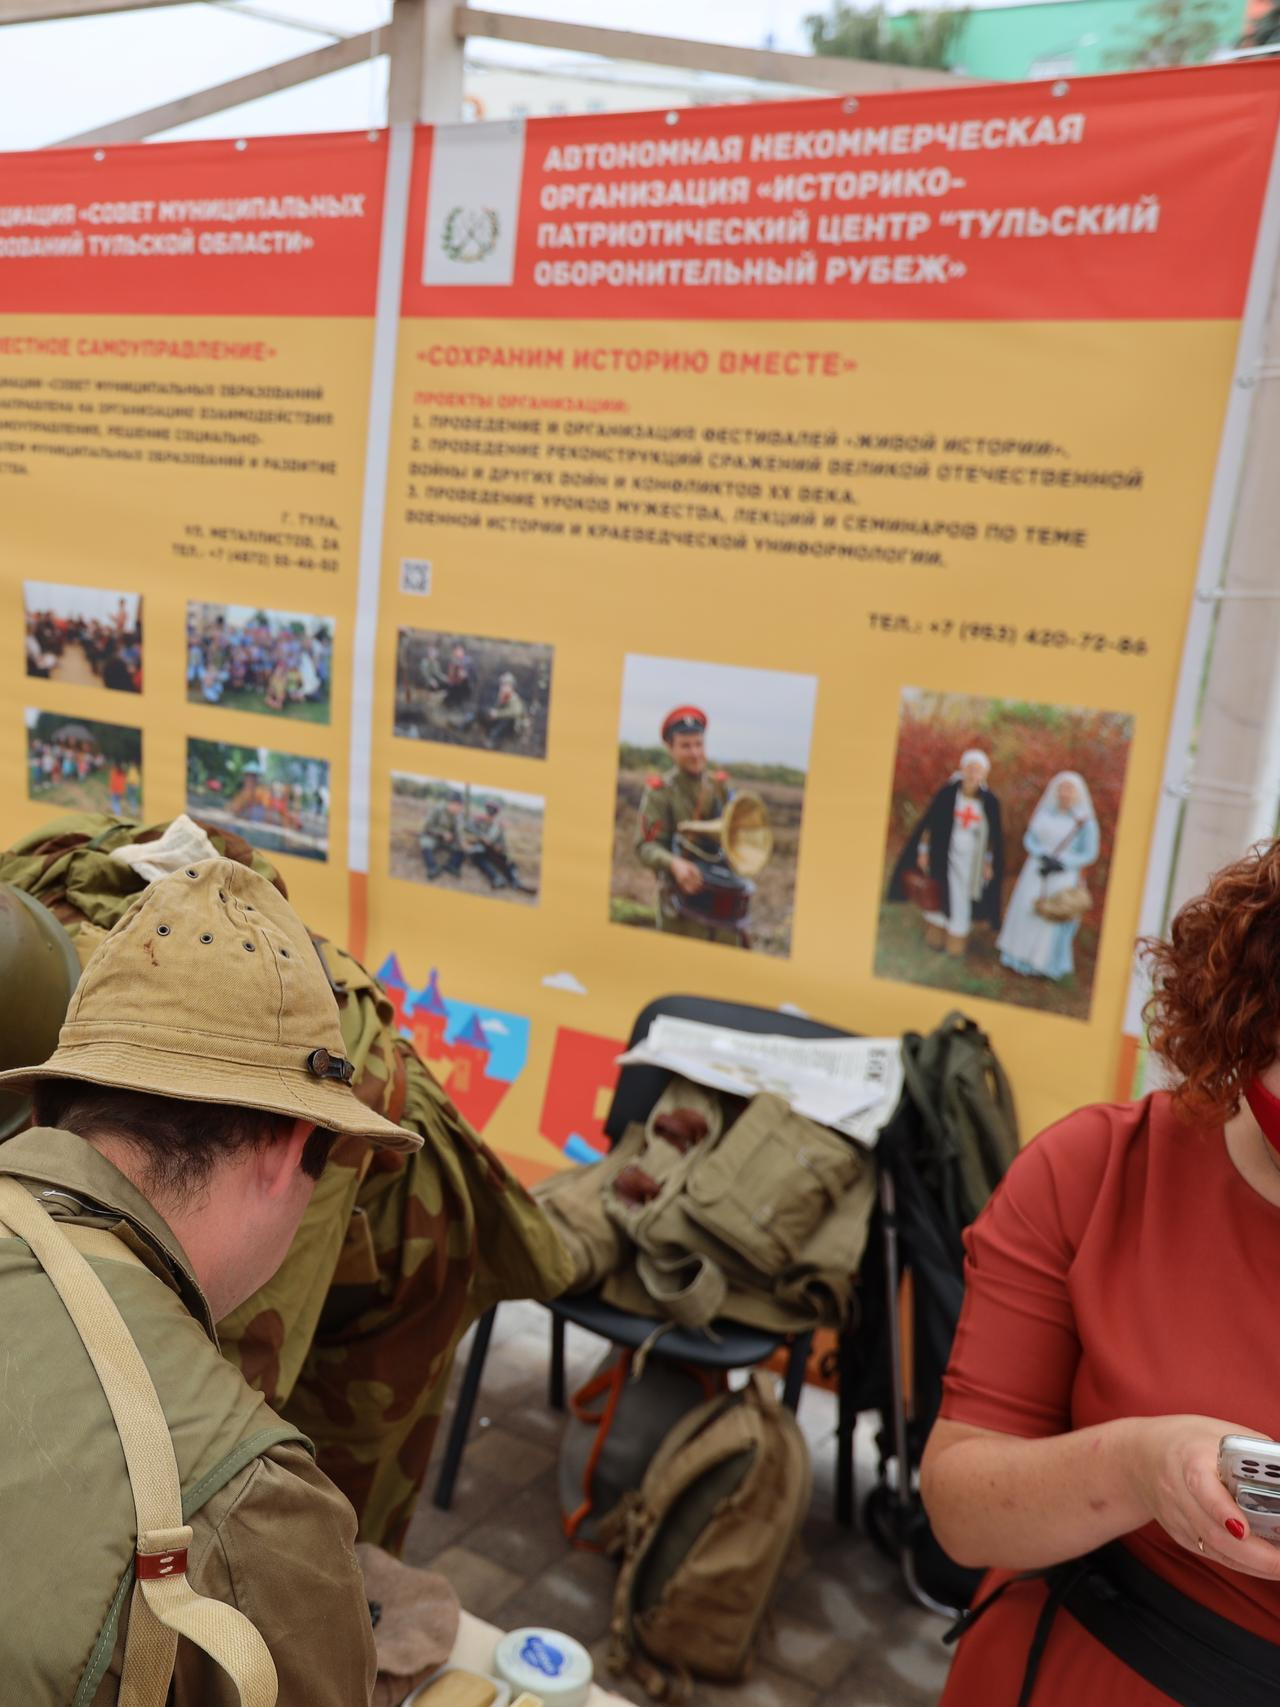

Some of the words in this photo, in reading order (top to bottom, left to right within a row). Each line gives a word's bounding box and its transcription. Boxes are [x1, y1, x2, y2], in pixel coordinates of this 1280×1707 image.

[542, 135, 743, 172] АВТОНОМНАЯ
[748, 113, 1086, 162] НЕКОММЕРЧЕСКАЯ
[540, 176, 751, 211] ОРГАНИЗАЦИЯ
[756, 166, 966, 203] «ИСТОРИКО-
[78, 201, 156, 225] «СОВЕТ
[158, 194, 365, 222] МУНИЦИПАЛЬНЫХ
[536, 208, 810, 248] ПАТРИОТИЧЕСКИЙ
[816, 211, 932, 245] ЦЕНТР
[88, 228, 195, 256] ТУЛЬСКОЙ
[198, 230, 314, 255] ОБЛАСТИ»
[533, 251, 818, 287] ОБОРОНИТЕЛЬНЫЙ
[824, 254, 966, 285] РУБЕЖ»
[77, 337, 277, 362] САМОУПРАВЛЕНИЕ»
[416, 345, 564, 371] «СОХРАНИМ
[572, 348, 710, 374] ИСТОРИЮ
[718, 351, 858, 377] ВМЕСТЕ»
[414, 391, 491, 408] ПРОЕКТЫ
[412, 416, 424, 430] 1.
[429, 414, 541, 435] ПРОВЕДЕНИЕ
[547, 420, 558, 435] И
[563, 421, 696, 442] ОРГАНИЗАЦИЯ
[702, 427, 838, 447] ФЕСТИВАЛЕЙ
[844, 431, 936, 452] «ЖИВОЙ
[408, 461, 467, 479] ВОЙНЫ
[473, 467, 484, 480] И
[489, 467, 555, 486] ДРУГИХ
[560, 470, 609, 488] ВОЙН
[614, 476, 626, 489] И
[632, 477, 763, 499] КОНФЛИКТОВ
[799, 486, 858, 504] ВЕКА.
[411, 438, 424, 452] 2.
[428, 437, 539, 458] ПРОВЕДЕНИЕ
[546, 444, 703, 467] РЕКОНСТРУКЦИЙ
[708, 452, 822, 473] СРАЖЕНИЙ
[828, 459, 930, 479] ВЕЛИКОЙ
[937, 464, 1144, 490] ОТЕЧЕСТВЕННОЙ
[408, 485, 420, 499] 3.
[424, 485, 535, 507] ПРОВЕДЕНИЕ
[543, 494, 610, 513] УРОКОВ
[616, 500, 727, 523] МУЖЕСТВА,
[733, 506, 817, 528] ЛЕКЦИЙ
[823, 513, 836, 528] И
[842, 514, 978, 540] СЕМИНАРОВ
[984, 523, 1018, 542] ПО
[1024, 526, 1088, 547] ТЕМЕ
[404, 508, 482, 529] ВОЕННОЙ
[487, 514, 565, 536] ИСТОРИИ
[571, 522, 582, 536] И
[587, 524, 747, 550] КРАЕВЕДЧЕСКОЙ
[754, 533, 945, 567] УНИФОРМОЛОГИИ.
[868, 611, 922, 633] ТЕЛ.:
[929, 618, 954, 637] +7
